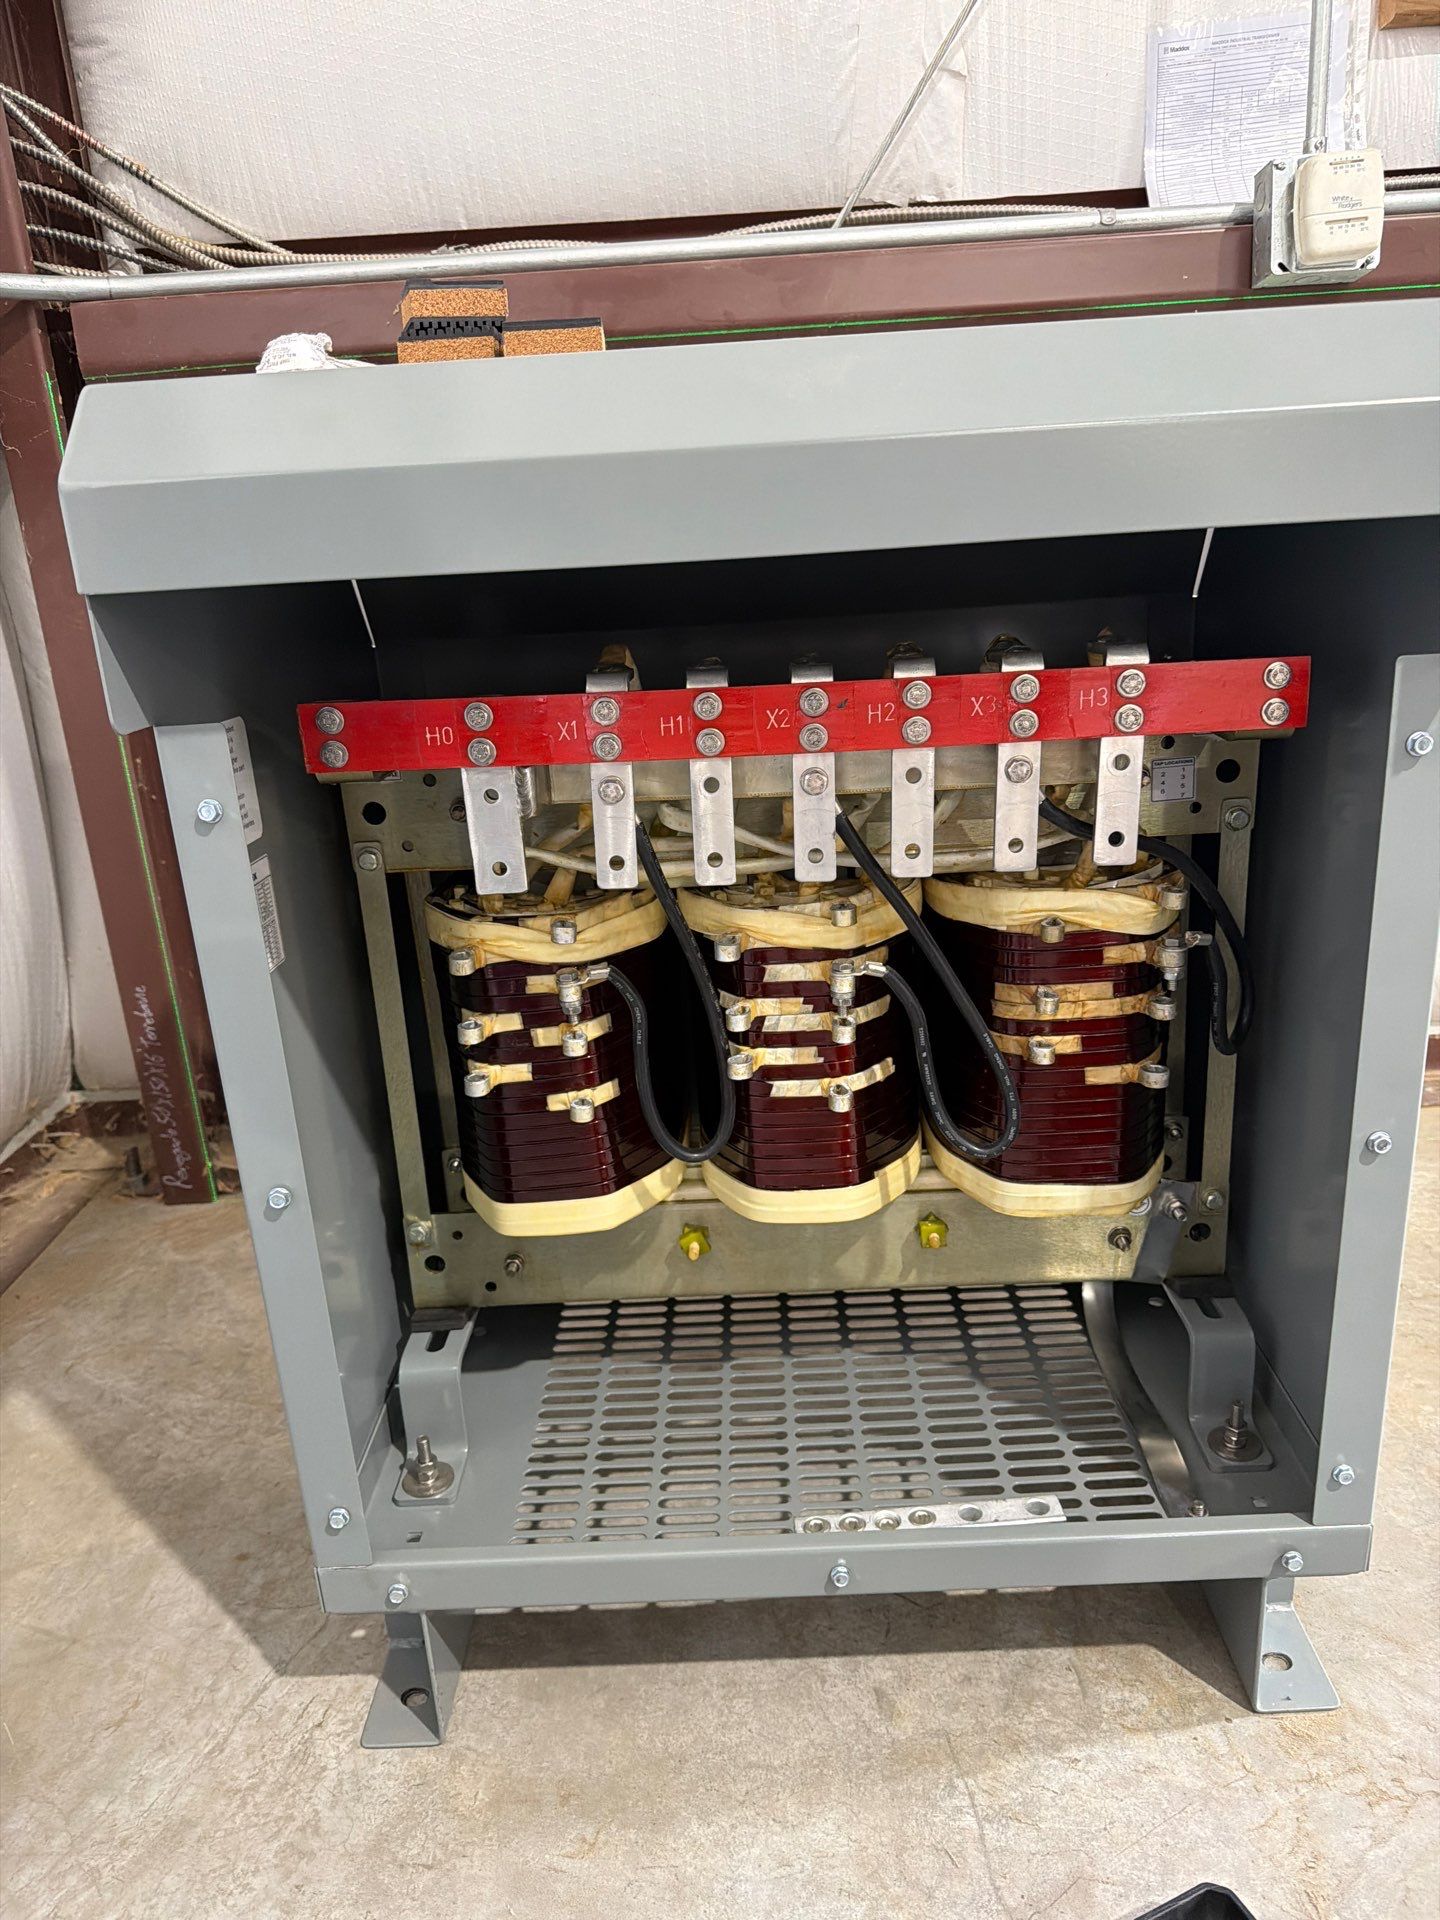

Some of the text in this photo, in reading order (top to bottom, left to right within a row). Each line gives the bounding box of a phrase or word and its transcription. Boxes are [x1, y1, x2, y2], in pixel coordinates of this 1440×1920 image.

[1170, 45, 1190, 53] Maddox
[1338, 201, 1362, 209] Rodgers
[557, 720, 578, 742] X1
[660, 715, 683, 736] H1
[765, 708, 791, 729] X2
[867, 702, 896, 724] H2
[971, 695, 997, 717] X3
[1079, 687, 1108, 710] H3
[983, 1033, 994, 1048] CABLE
